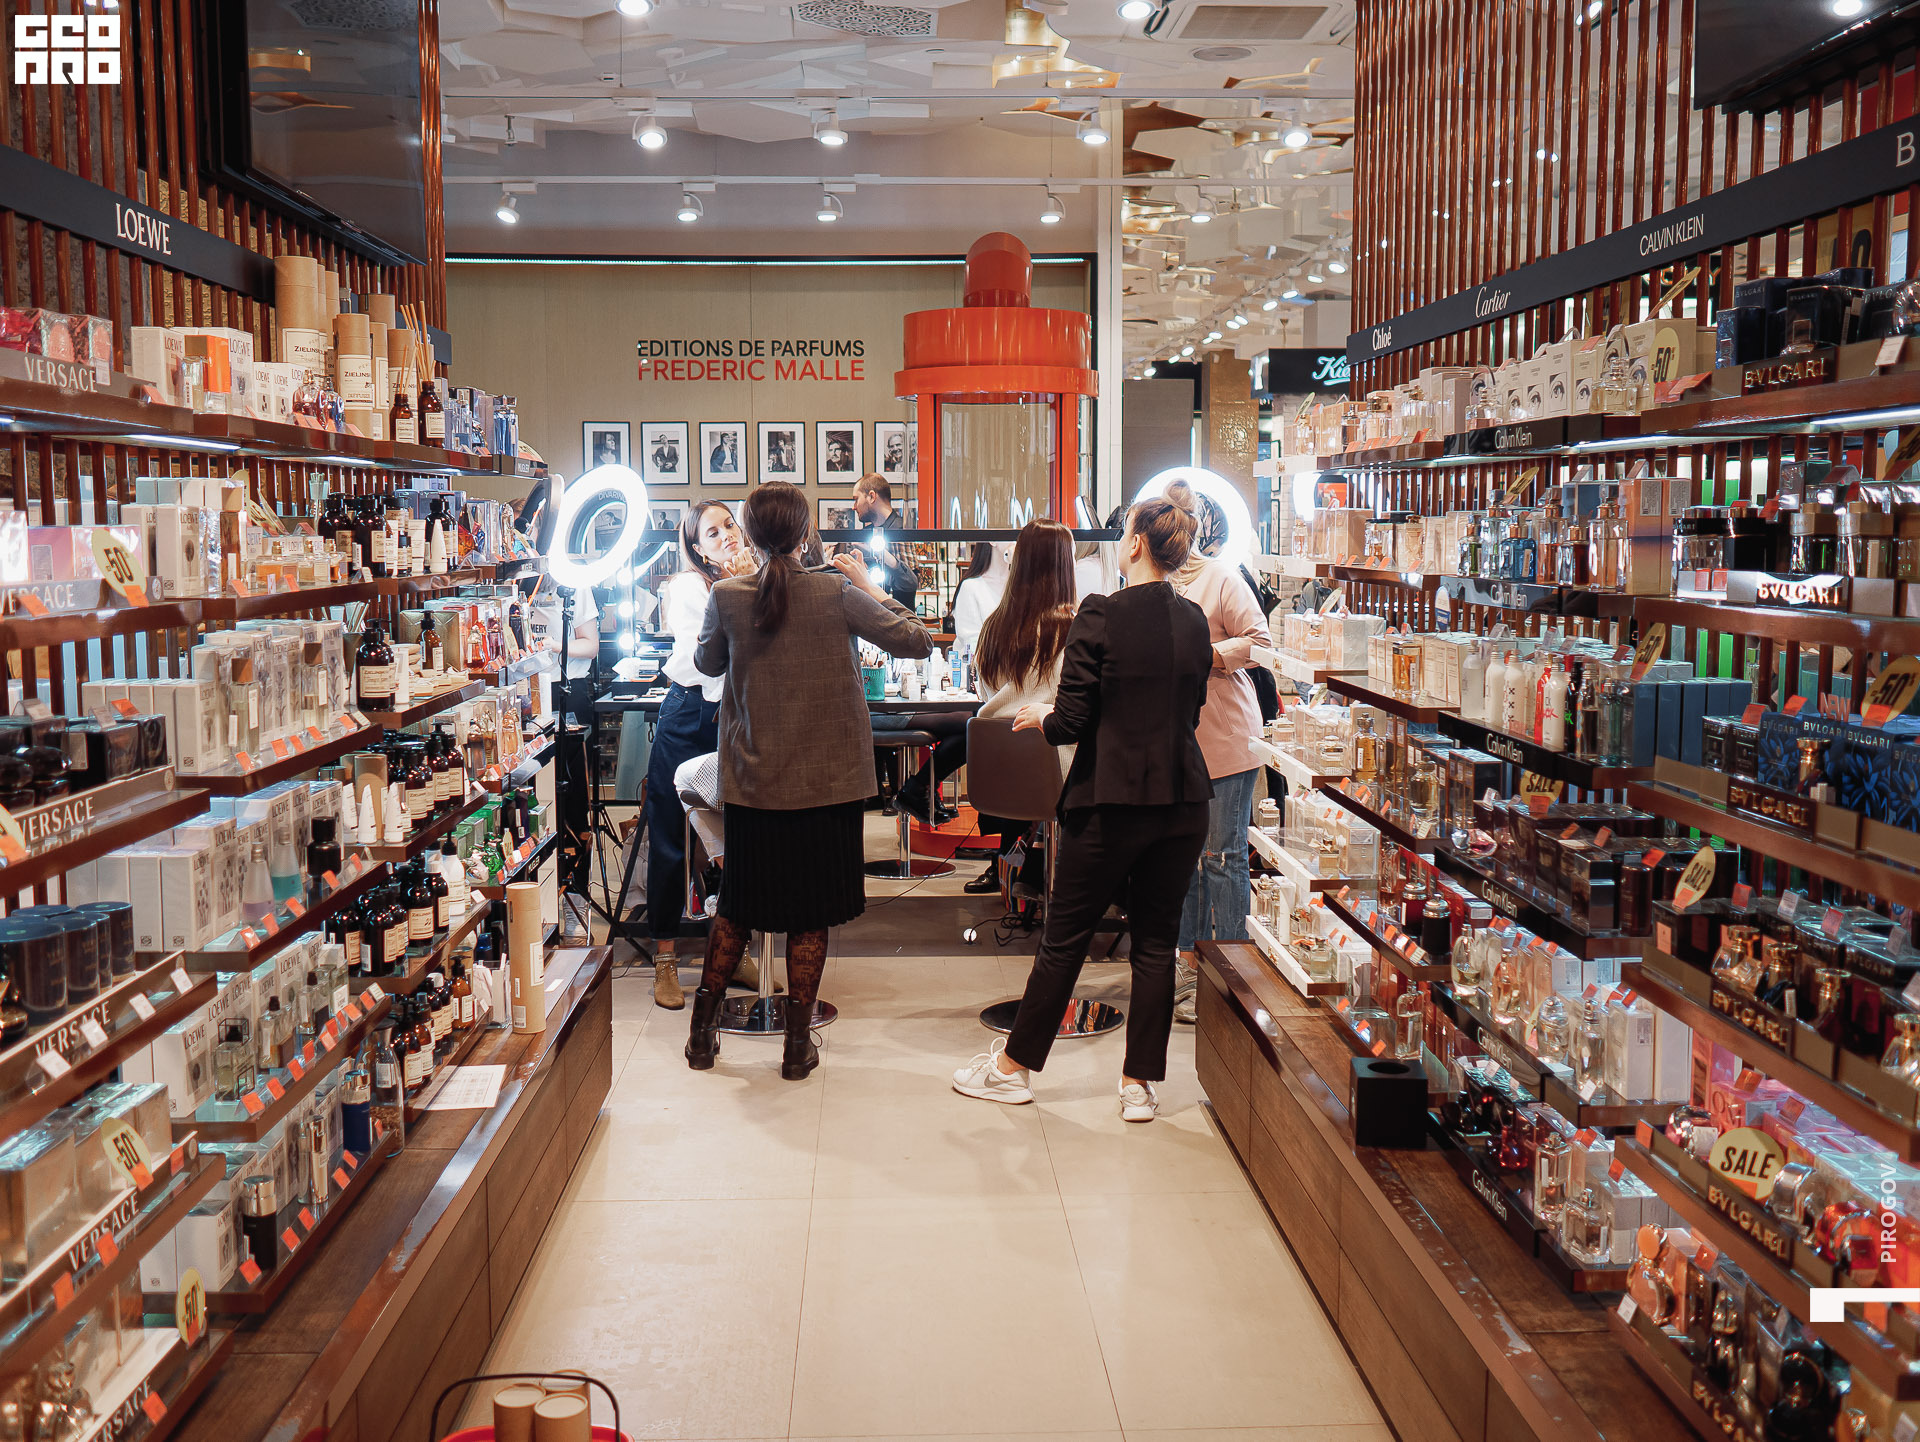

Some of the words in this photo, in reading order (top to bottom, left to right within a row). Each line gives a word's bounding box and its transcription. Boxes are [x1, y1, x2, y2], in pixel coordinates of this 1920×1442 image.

[115, 203, 172, 255] LOEWE
[1639, 226, 1675, 256] CALVIN
[1674, 213, 1704, 244] KLEIN
[1475, 285, 1512, 319] Cartier
[637, 339, 733, 357] EDITIONS
[738, 340, 765, 357] DE
[770, 339, 866, 357] PARFUMS
[1372, 325, 1392, 351] Chloé
[24, 356, 98, 393] VERSACE
[637, 358, 766, 381] FREDERIC
[774, 359, 866, 381] MALLE
[1757, 581, 1840, 606] BVLGARI
[1820, 691, 1851, 723] NEW
[1803, 721, 1847, 739] BVLGARI
[1847, 731, 1891, 750] BVLGARI
[208, 993, 230, 1022] LOEWE
[184, 1024, 205, 1050] LOEWE
[1720, 1145, 1776, 1180] SALE
